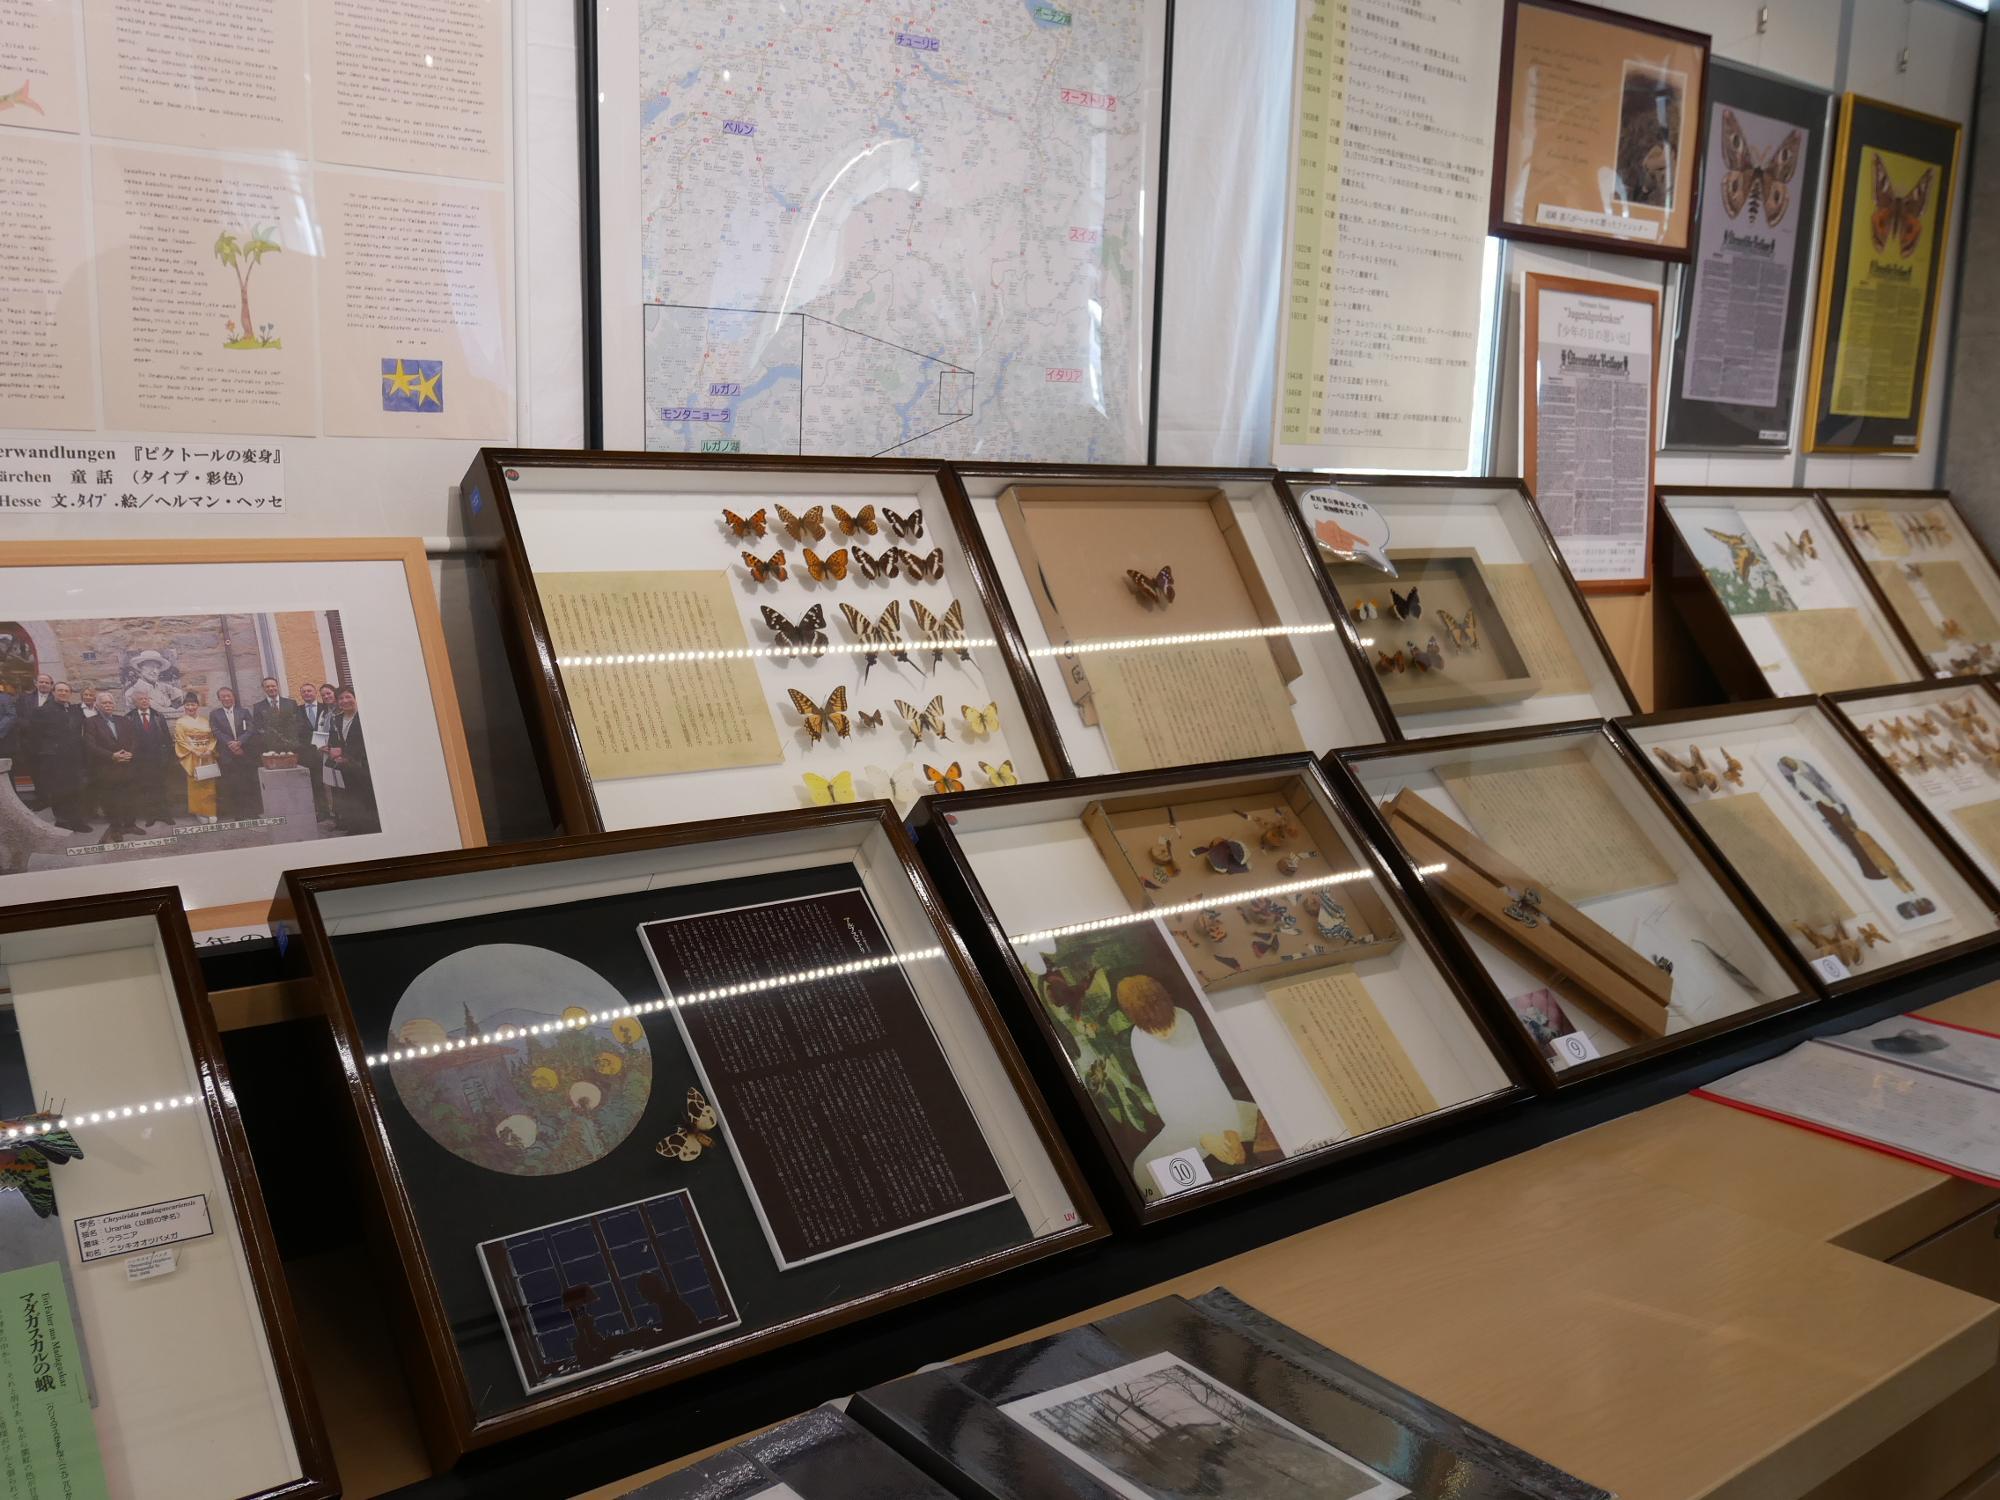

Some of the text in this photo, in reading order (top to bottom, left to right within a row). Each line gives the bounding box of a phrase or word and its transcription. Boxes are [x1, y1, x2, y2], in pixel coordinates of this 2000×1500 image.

[897, 33, 939, 50] チューリヒ
[724, 121, 754, 136] ベルン
[1070, 227, 1097, 242] スイス
[710, 383, 739, 396] ルガノ
[662, 408, 730, 421] モンタニョーラ
[134, 446, 281, 464] 『ピクトールの変身』
[19, 1292, 56, 1393] マダガスカルの蛾
